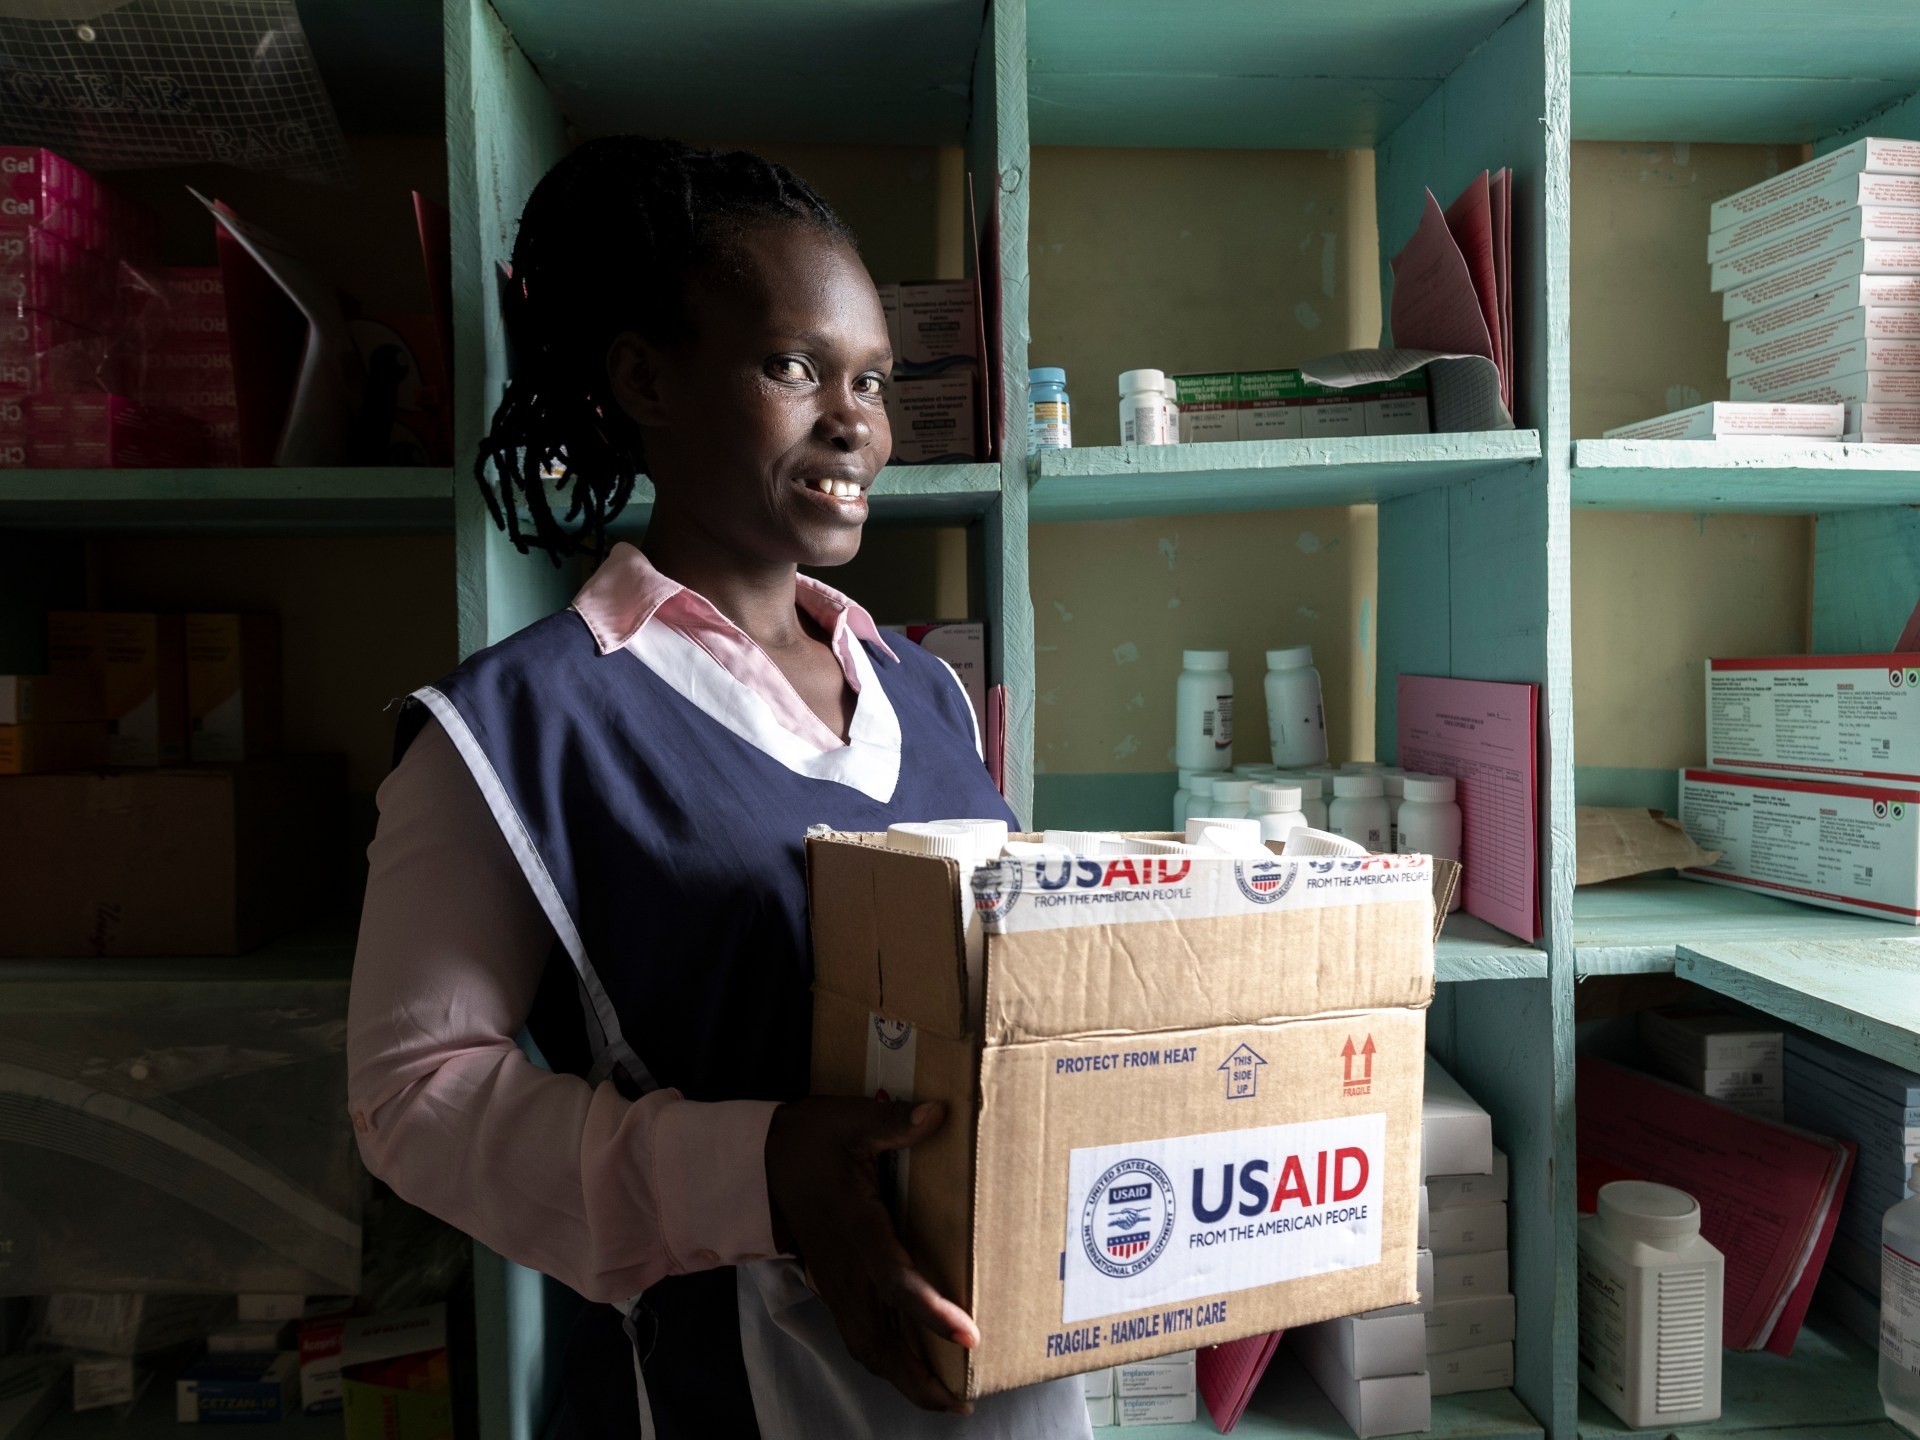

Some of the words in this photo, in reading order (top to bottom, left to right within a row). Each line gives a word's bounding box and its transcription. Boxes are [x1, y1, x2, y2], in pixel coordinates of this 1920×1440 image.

[197, 121, 314, 162] BAG
[2, 157, 35, 173] Gel
[2, 200, 35, 216] Gel
[950, 660, 963, 669] ine
[964, 662, 974, 670] en
[1036, 854, 1191, 890] USAID
[1307, 876, 1334, 890] FROM
[1334, 875, 1352, 887] THE
[1352, 873, 1399, 886] AMERICAN
[1034, 894, 1067, 909] FROM
[1068, 892, 1090, 905] THE
[1091, 889, 1151, 904] AMERICAN
[1152, 887, 1192, 900] PEOPLE
[1056, 1053, 1119, 1074] PROTECT
[1122, 1050, 1160, 1069] FROM
[1163, 1047, 1197, 1065] HEAT
[1233, 1055, 1253, 1067] THIS
[1233, 1069, 1253, 1082] SIDE
[1236, 1084, 1249, 1096] UP
[1343, 1085, 1372, 1098] FRAGILE
[1088, 1171, 1116, 1206] UNITED
[1115, 1161, 1148, 1175] STATES
[1146, 1164, 1172, 1194] AGENCY
[1192, 1146, 1369, 1224] USAID
[1112, 1186, 1149, 1201] USAID
[1189, 1228, 1227, 1249] FROM
[1229, 1224, 1254, 1241] THE
[1255, 1213, 1322, 1238] AMERICAN
[1325, 1204, 1368, 1226] PEOPLE
[1083, 1224, 1131, 1276] INTERNATIONAL
[1131, 1211, 1174, 1274] DEVELOPMENT
[1046, 1325, 1101, 1358] FRAGILE
[1110, 1313, 1160, 1345] HANDLE
[1162, 1306, 1193, 1335] WITH
[1196, 1300, 1227, 1328] CARE
[1122, 1369, 1155, 1378] Implanon
[1123, 1399, 1155, 1408] Implanon
